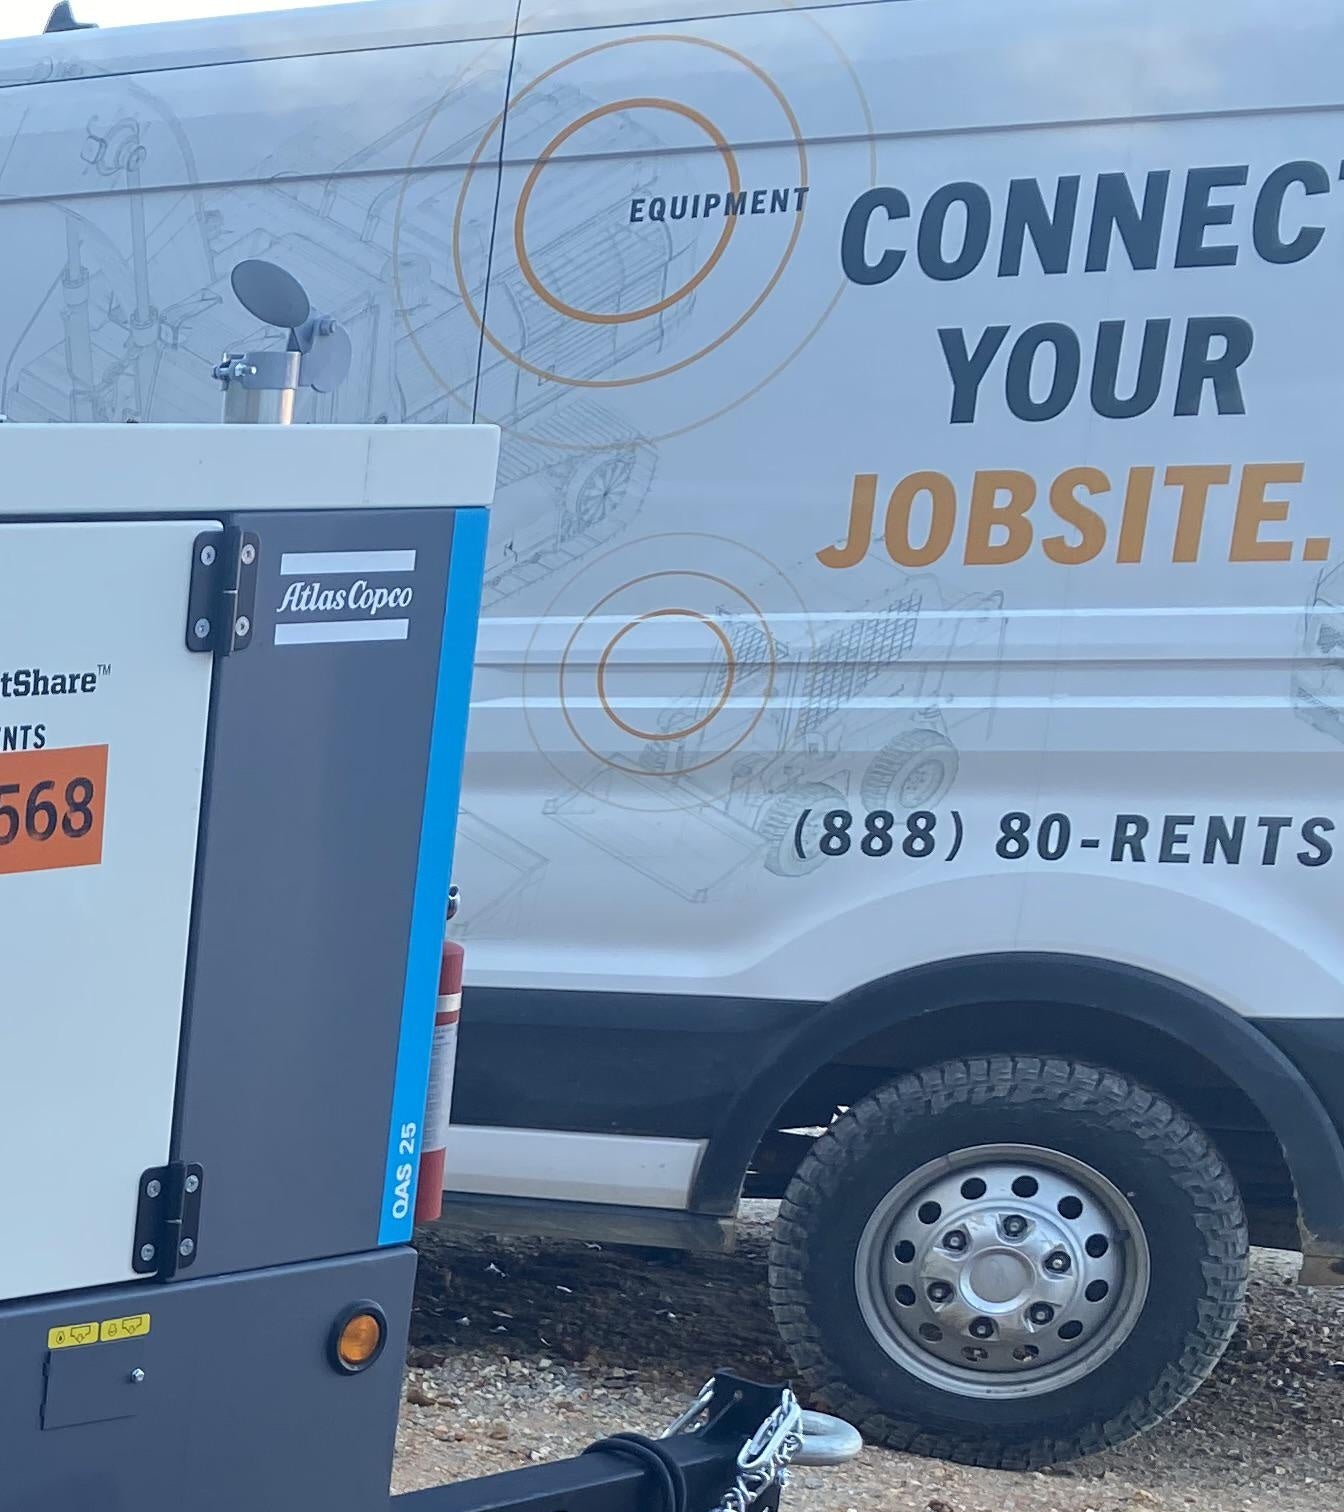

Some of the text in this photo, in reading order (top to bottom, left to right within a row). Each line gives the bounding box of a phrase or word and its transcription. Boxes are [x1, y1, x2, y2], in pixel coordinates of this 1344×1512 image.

[629, 186, 811, 224] EQUIPMENT
[840, 158, 1344, 286] CONNEC
[937, 316, 1255, 424] YOUR
[815, 461, 1332, 569] JOBSITE.
[794, 809, 1335, 867] (888) 80-RENTS
[399, 1122, 417, 1155] 25
